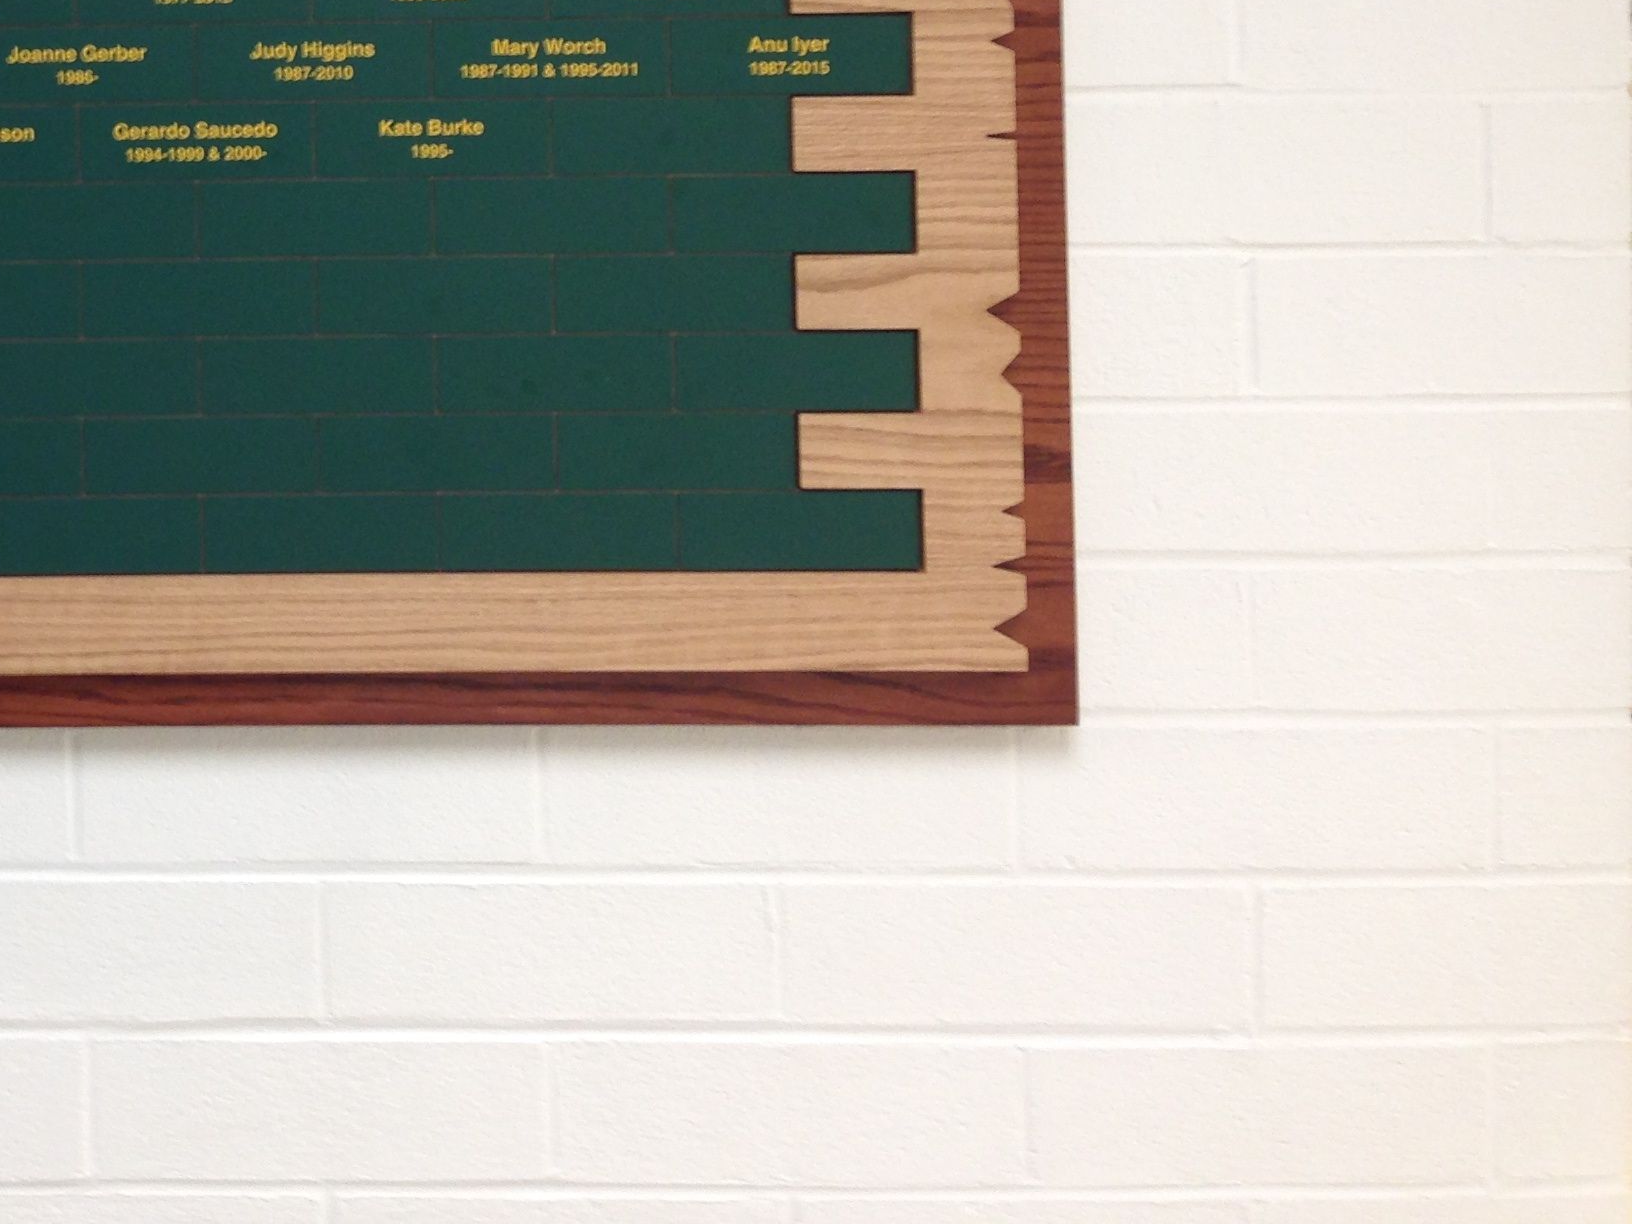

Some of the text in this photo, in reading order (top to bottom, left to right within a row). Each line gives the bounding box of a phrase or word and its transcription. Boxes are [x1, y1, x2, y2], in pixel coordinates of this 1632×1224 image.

[7, 43, 146, 64] Joanne Gerber
[250, 41, 376, 63] Judy Higgins
[490, 38, 607, 59] Mary Worch
[747, 35, 830, 57] Anu Iyer
[275, 65, 354, 82] 1987-2010
[460, 61, 639, 79] 1987-1991 & 1995-2011
[750, 60, 831, 76] 1987-2015
[112, 120, 279, 141] Gerardo Saucedo
[378, 118, 485, 137] Kate Burke
[207, 145, 221, 162] &
[411, 143, 453, 159] 1995-
